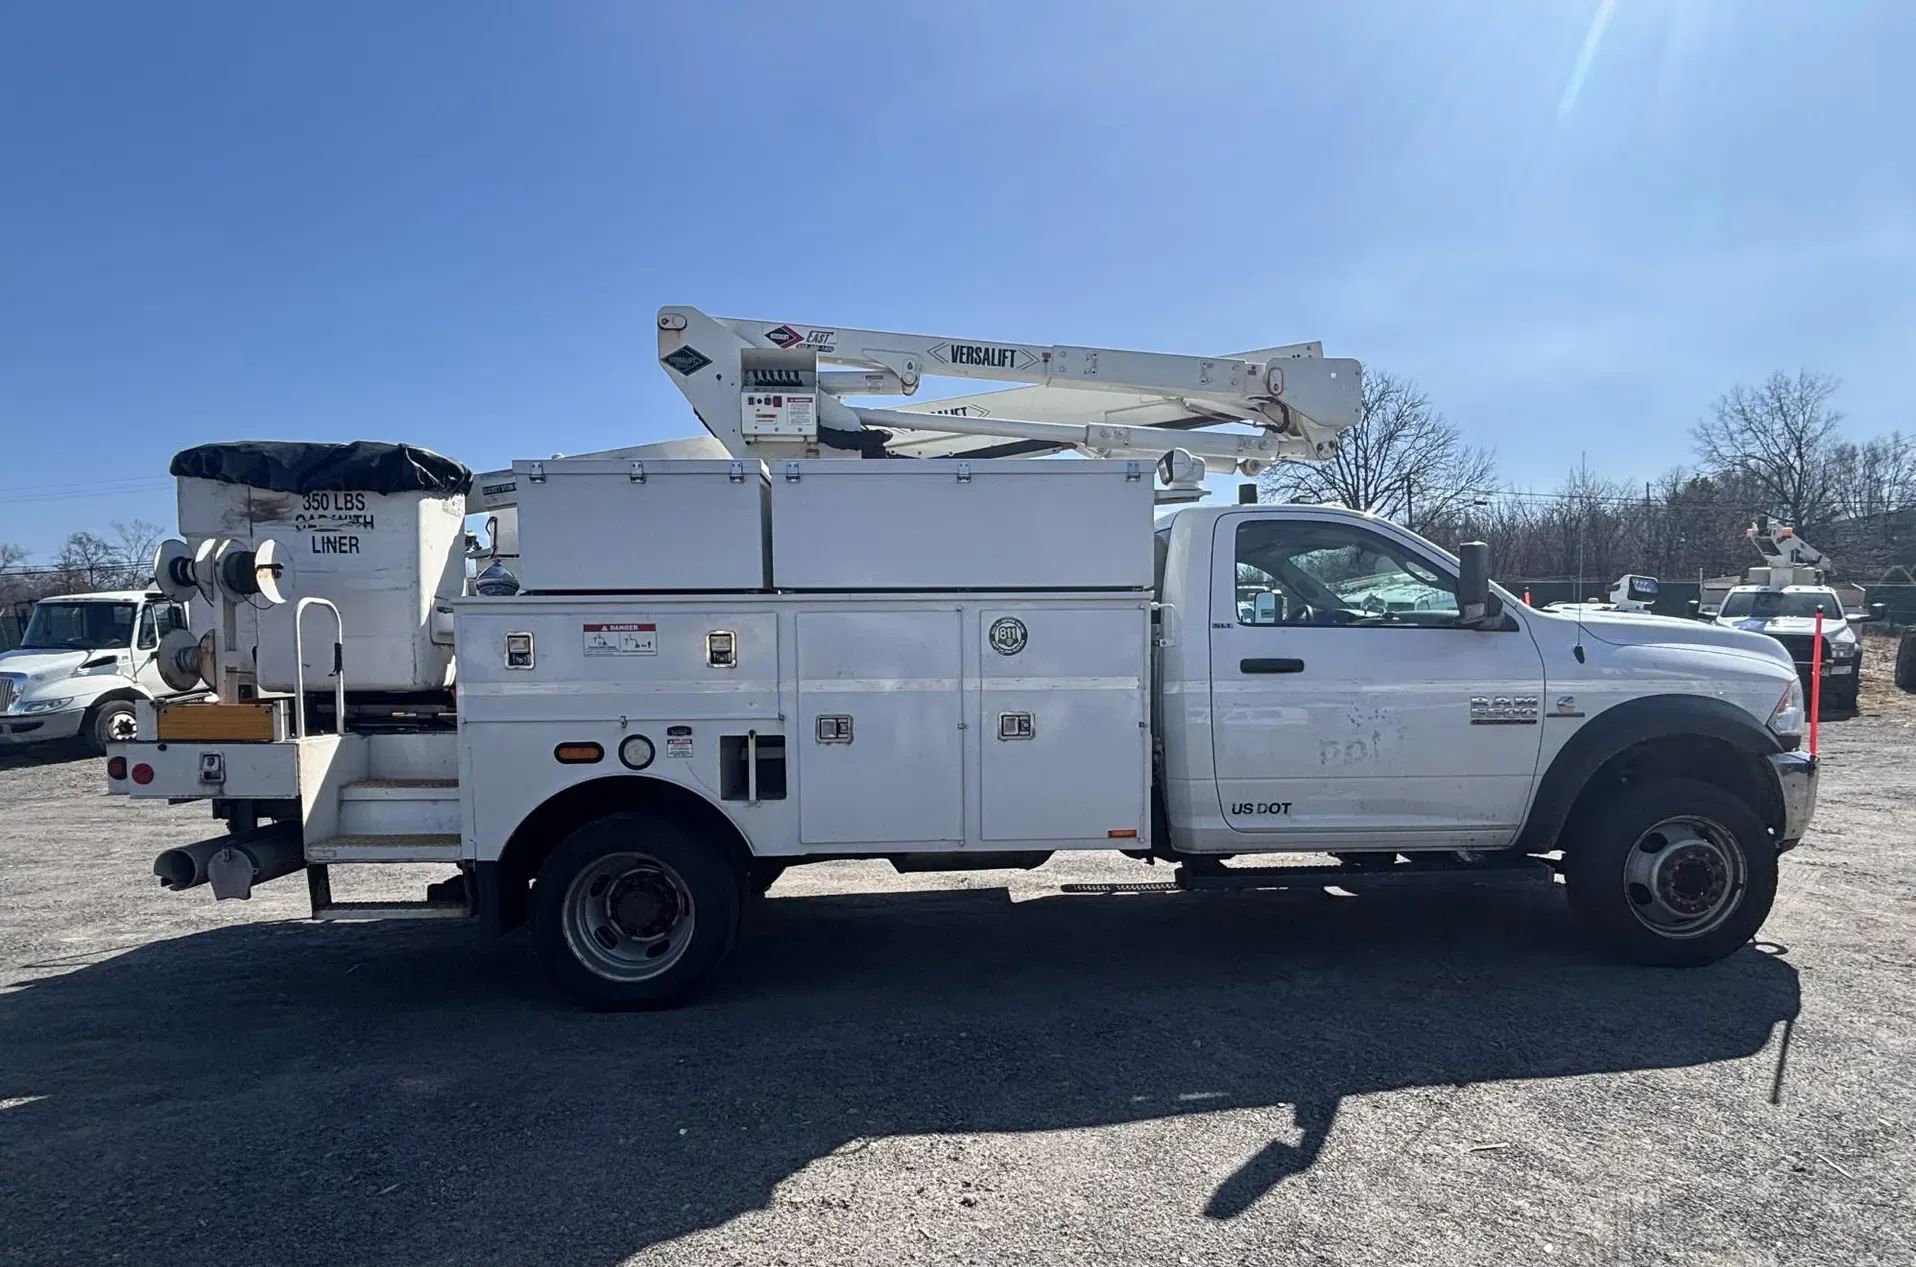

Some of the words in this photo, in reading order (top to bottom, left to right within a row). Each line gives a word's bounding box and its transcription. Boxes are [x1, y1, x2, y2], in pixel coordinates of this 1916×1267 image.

[951, 345, 1016, 368] VERSALIFT
[302, 493, 330, 511] 350
[334, 493, 365, 511] LBS
[312, 535, 360, 554] LINER
[1000, 627, 1016, 640] 811
[1471, 696, 1537, 707] RAM
[1231, 802, 1254, 815] US
[1256, 802, 1293, 815] DOT
